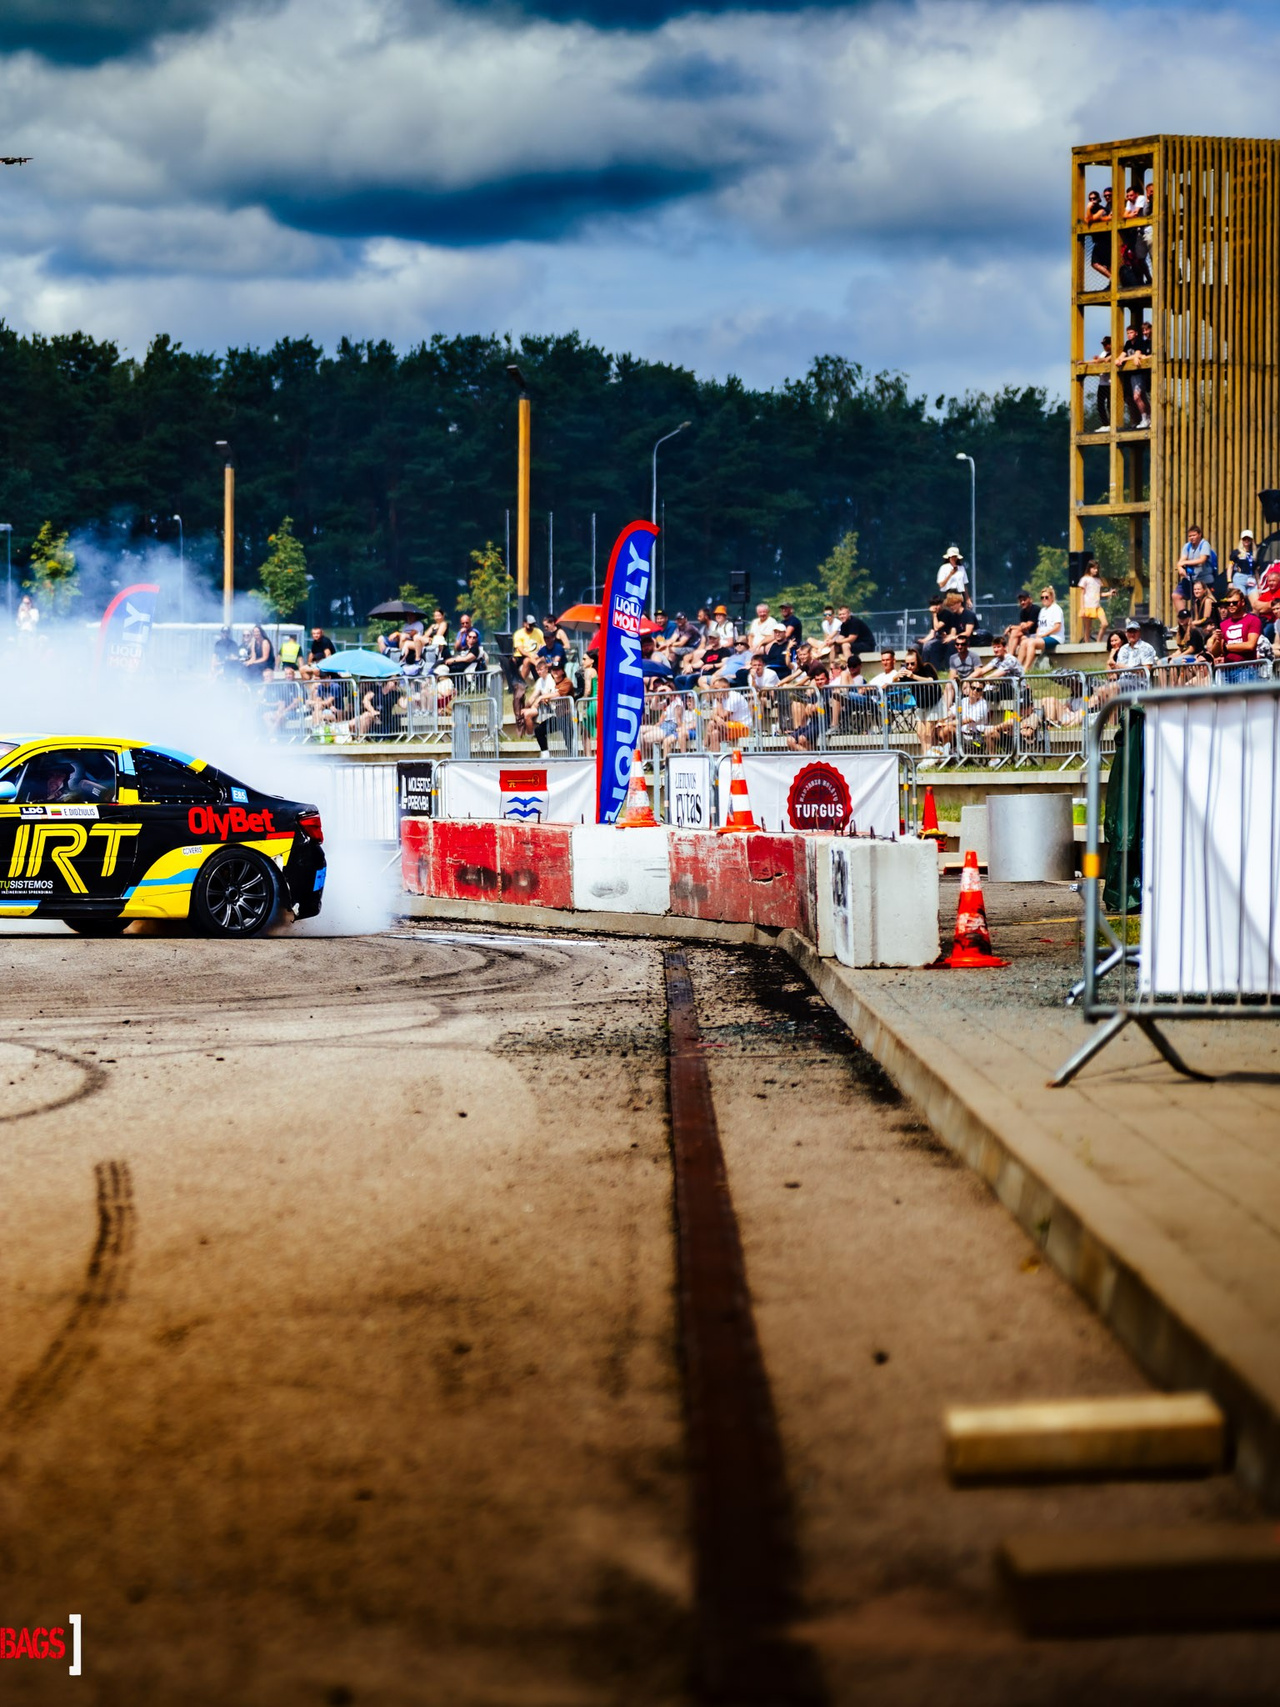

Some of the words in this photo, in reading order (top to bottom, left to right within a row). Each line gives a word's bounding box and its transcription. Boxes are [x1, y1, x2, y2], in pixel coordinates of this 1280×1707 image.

[233, 789, 246, 800] E85
[676, 791, 702, 828] rytas
[795, 803, 844, 818] TURGUS
[188, 806, 276, 841] OlyBet
[7, 823, 143, 894] IRT
